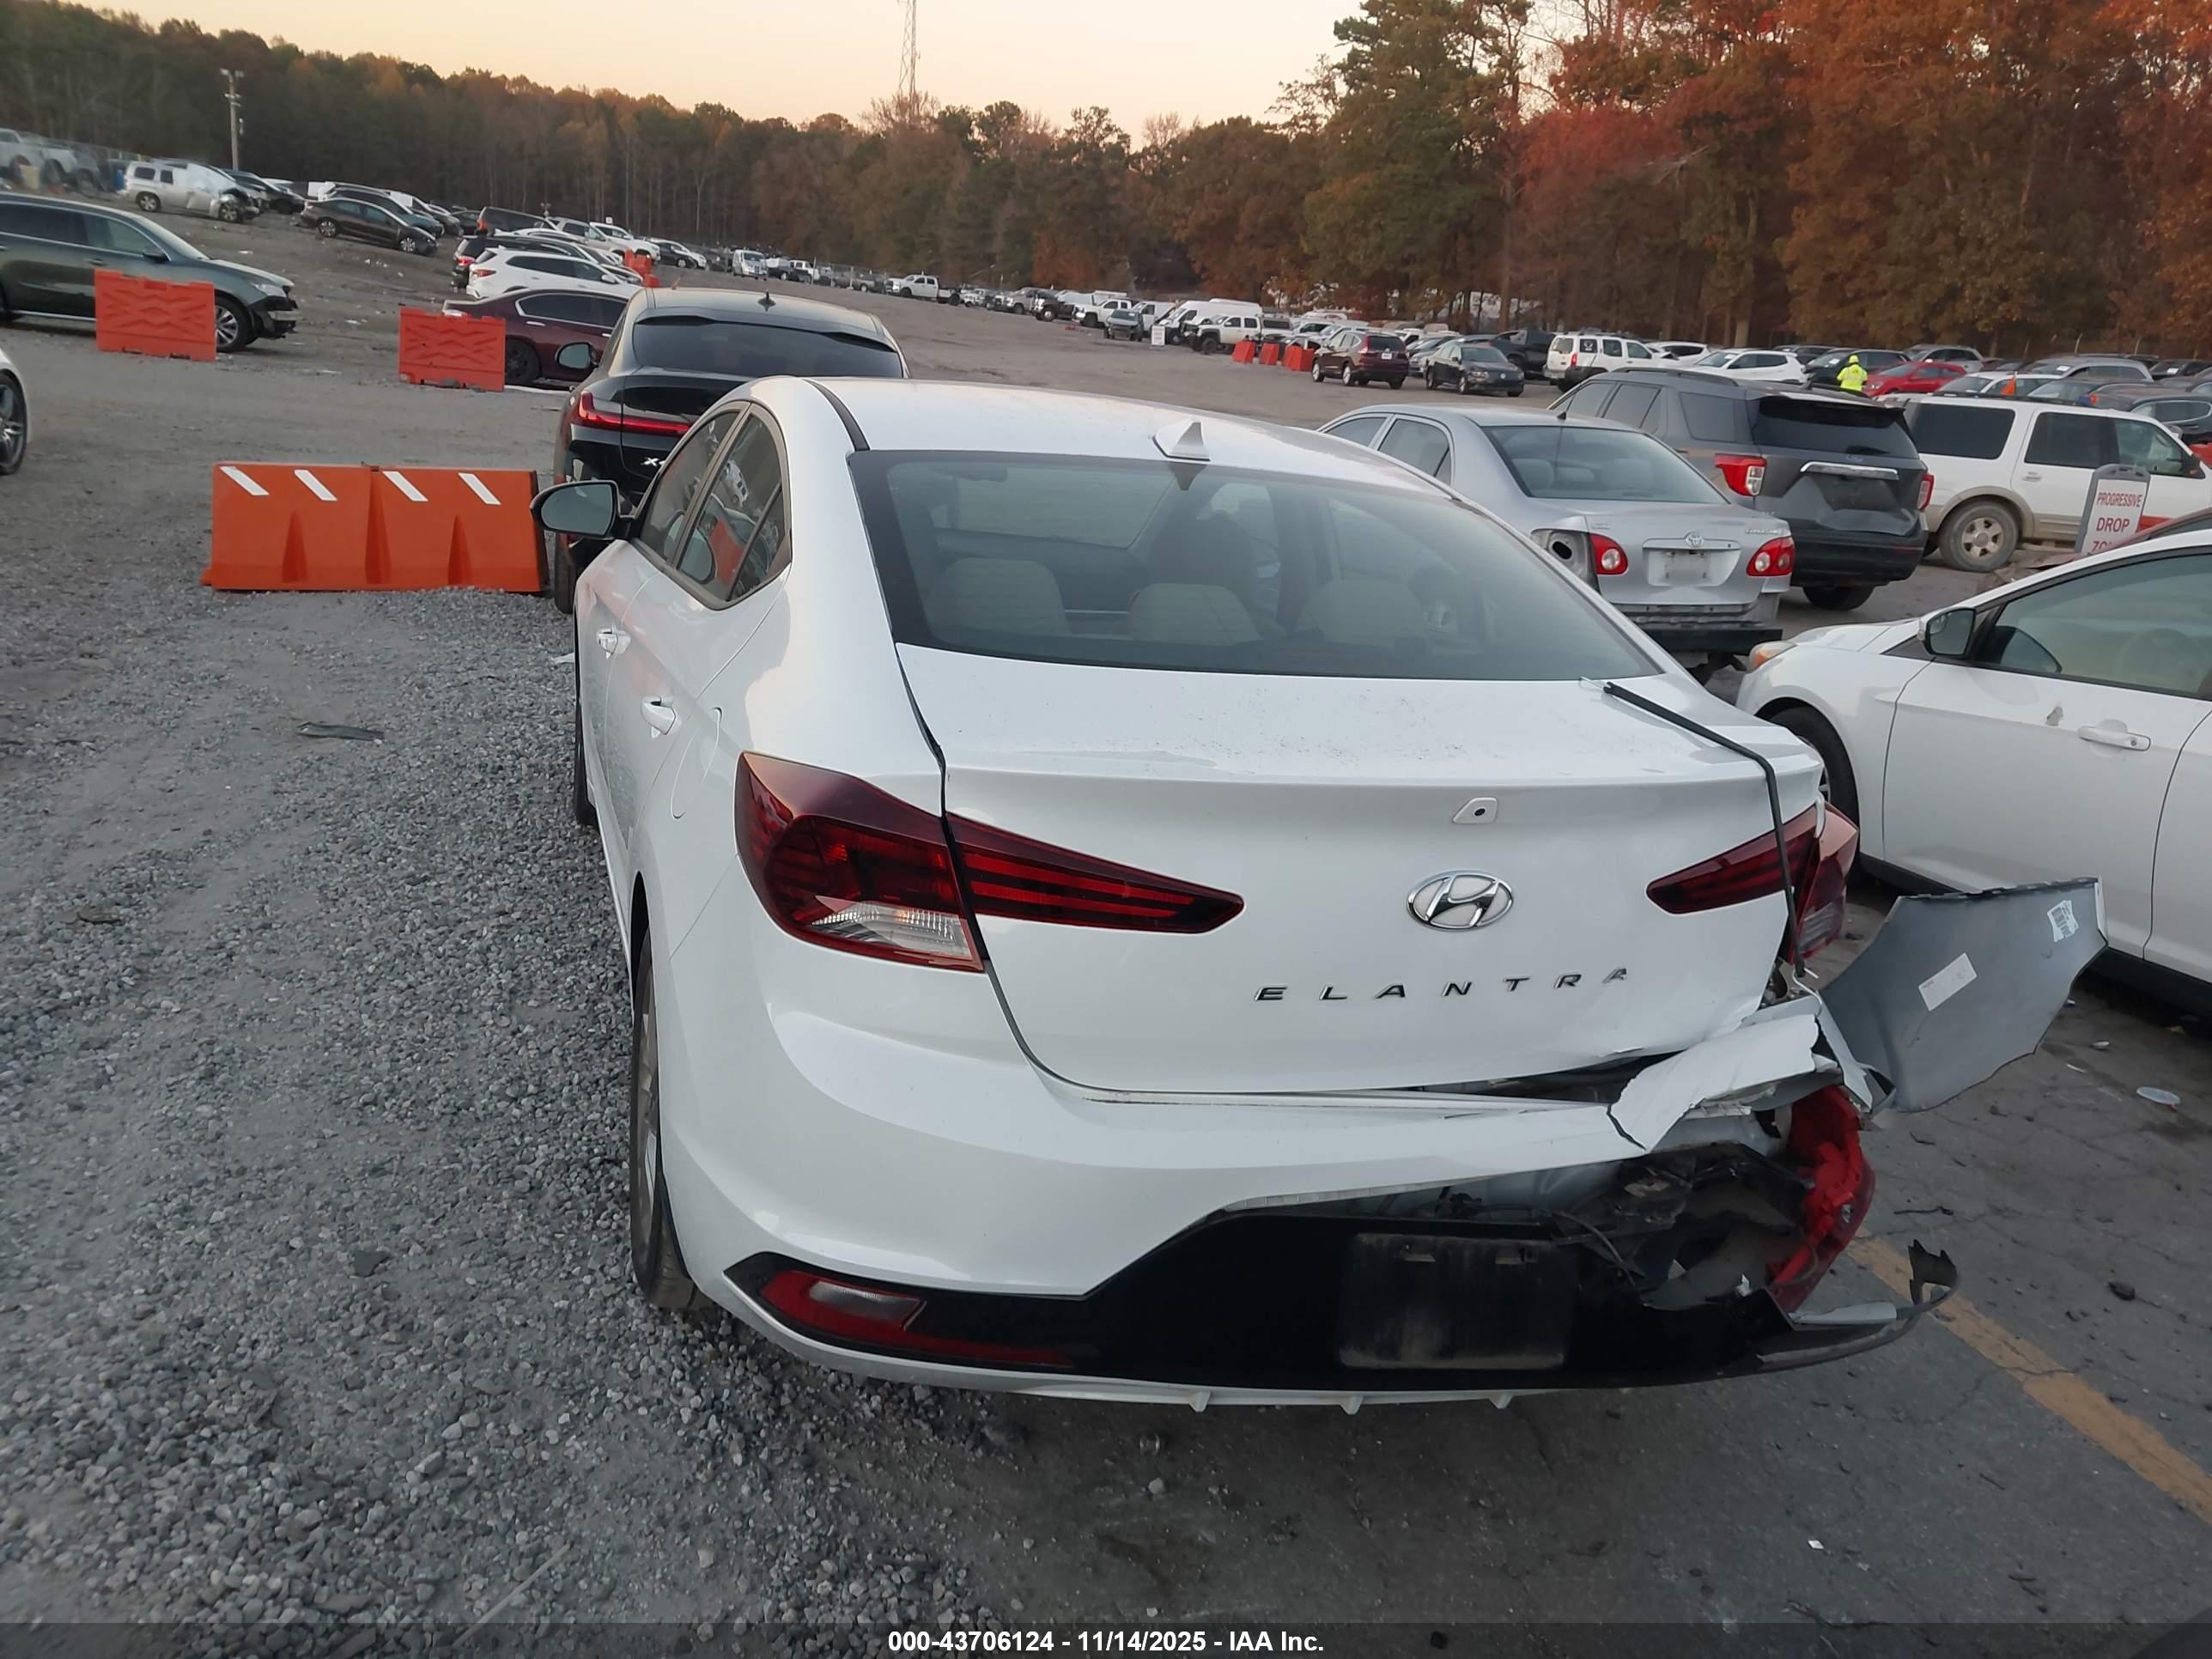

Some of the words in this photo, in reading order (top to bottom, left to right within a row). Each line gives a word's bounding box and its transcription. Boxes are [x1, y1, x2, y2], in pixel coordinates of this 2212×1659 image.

[2097, 492, 2142, 507] PROGRESSIVE
[2096, 517, 2130, 532] DROP
[1253, 967, 1627, 1001] ELANTRA
